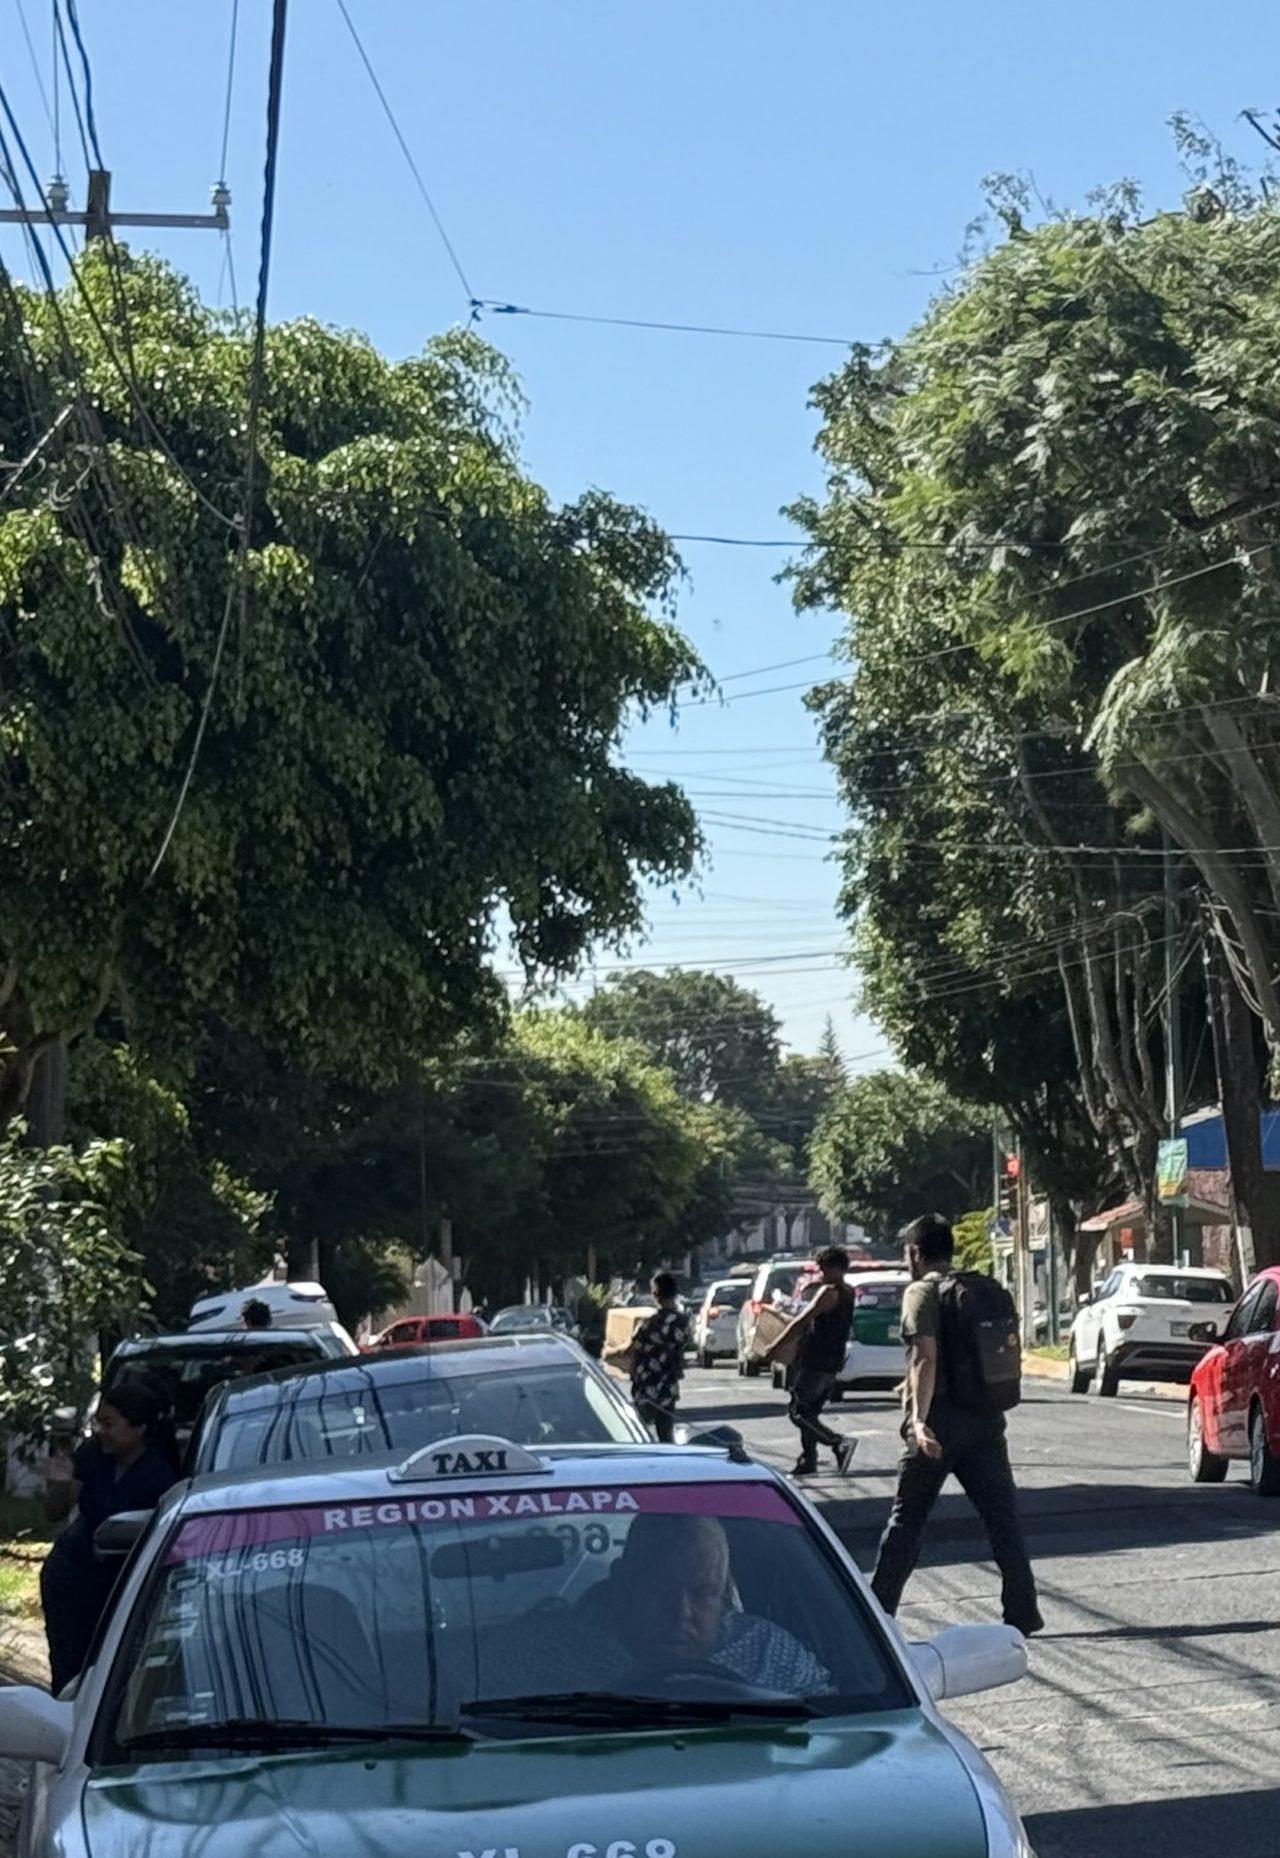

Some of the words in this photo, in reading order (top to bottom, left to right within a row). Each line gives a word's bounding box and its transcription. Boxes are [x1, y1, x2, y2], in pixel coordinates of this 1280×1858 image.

[432, 1450, 508, 1474] TAXI
[324, 1498, 475, 1531] REGION
[487, 1491, 640, 1515] XALAPA
[206, 1548, 305, 1579] XL-668
